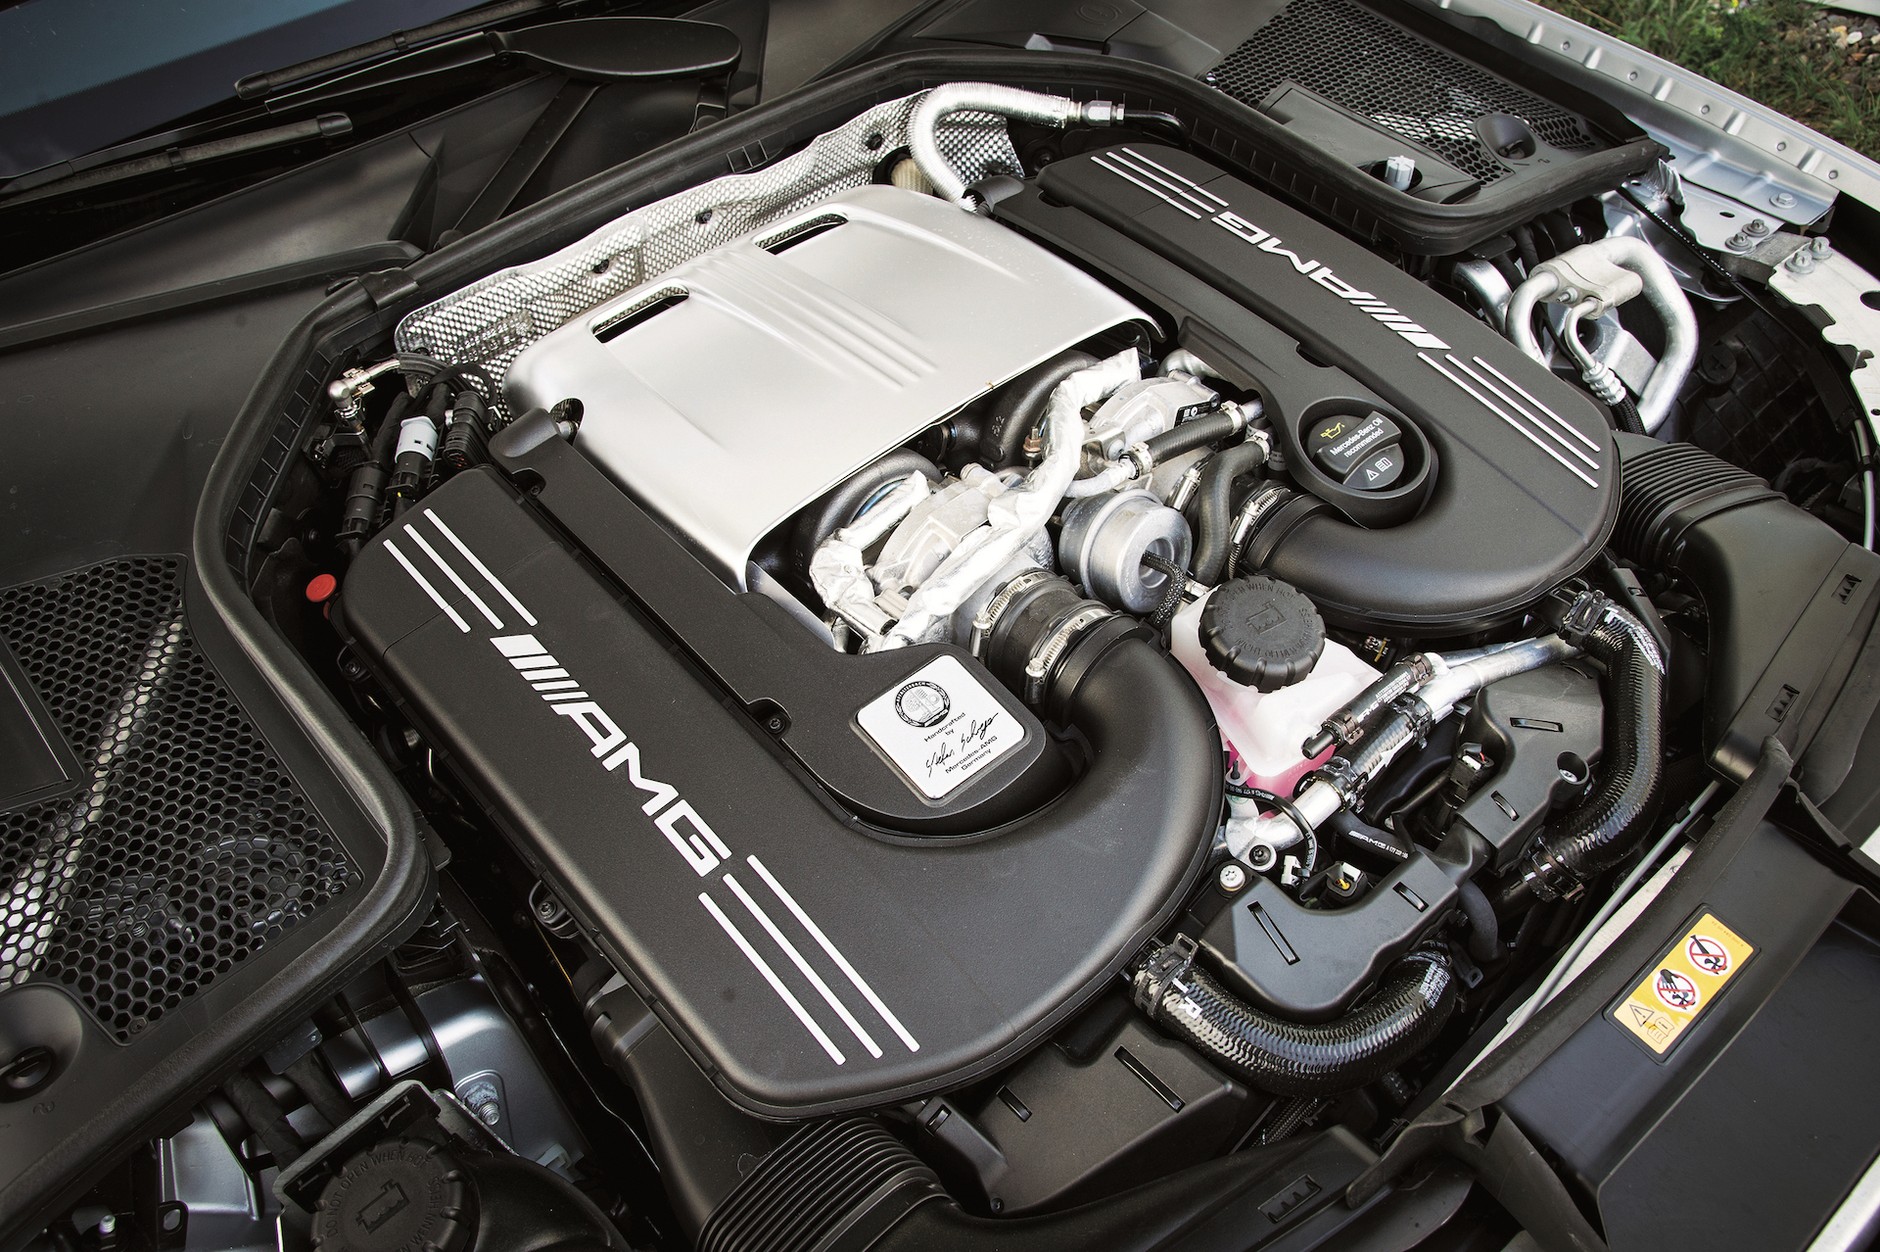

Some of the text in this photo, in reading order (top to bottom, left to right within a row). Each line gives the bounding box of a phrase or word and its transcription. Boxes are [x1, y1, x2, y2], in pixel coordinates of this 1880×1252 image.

[1330, 417, 1384, 456] Mercedes-Benz Oil
[1344, 428, 1384, 458] recommended
[924, 712, 966, 742] Handcrafted
[945, 728, 955, 736] by
[945, 735, 998, 774] Mercedes-AMG
[961, 749, 992, 771] Germany
[550, 701, 732, 877] AMG
[371, 1150, 405, 1166] WHEN
[341, 1161, 369, 1191] OPEN
[325, 1190, 342, 1217] NOT
[326, 1220, 339, 1238] DO
[411, 1212, 437, 1246] WENN
